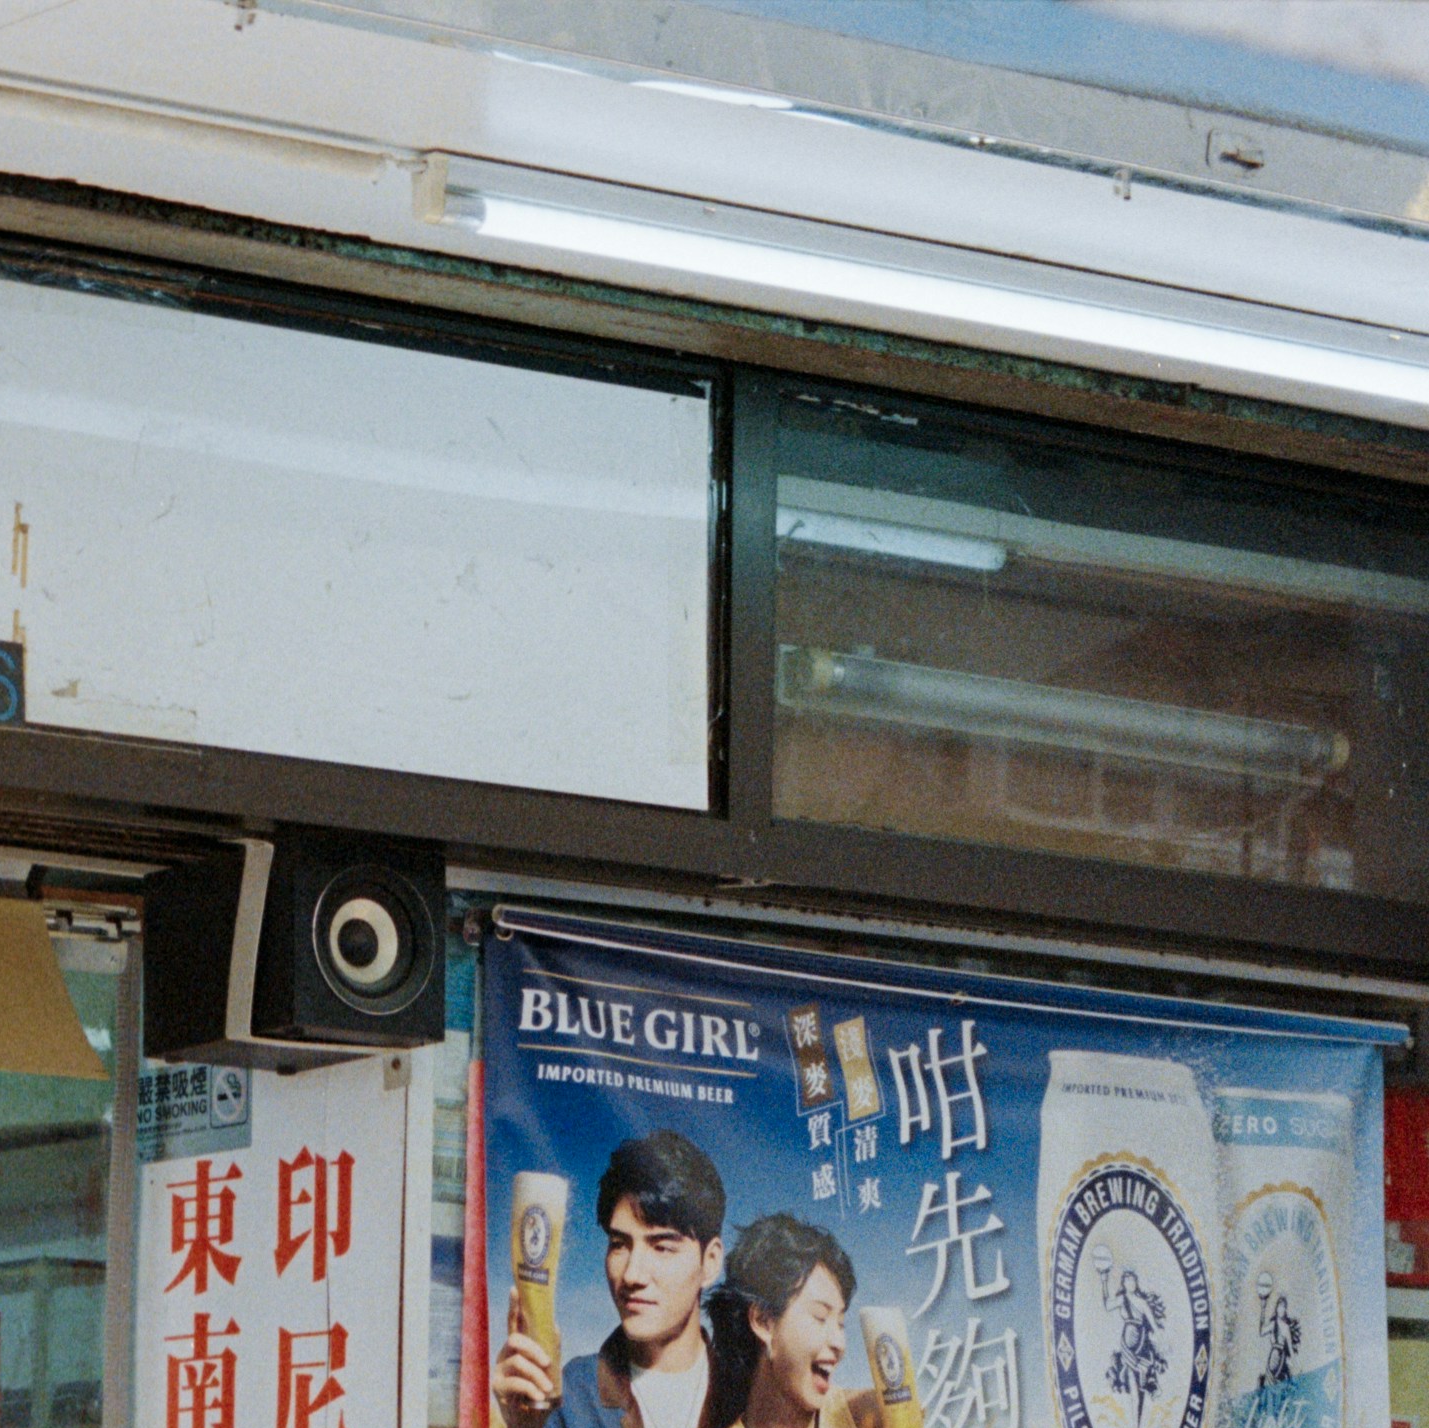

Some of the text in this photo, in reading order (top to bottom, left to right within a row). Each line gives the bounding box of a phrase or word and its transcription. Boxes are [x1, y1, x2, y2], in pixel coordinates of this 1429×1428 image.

[518, 987, 759, 1062] BLUE GIRL
[136, 1098, 208, 1124] NO SMOKING
[536, 1063, 735, 1105] IMPORTED PREMIUM BEER
[1055, 1224, 1083, 1320] GERMAN
[1074, 1176, 1161, 1226] BREWING
[1160, 1207, 1210, 1330] TRADITION
